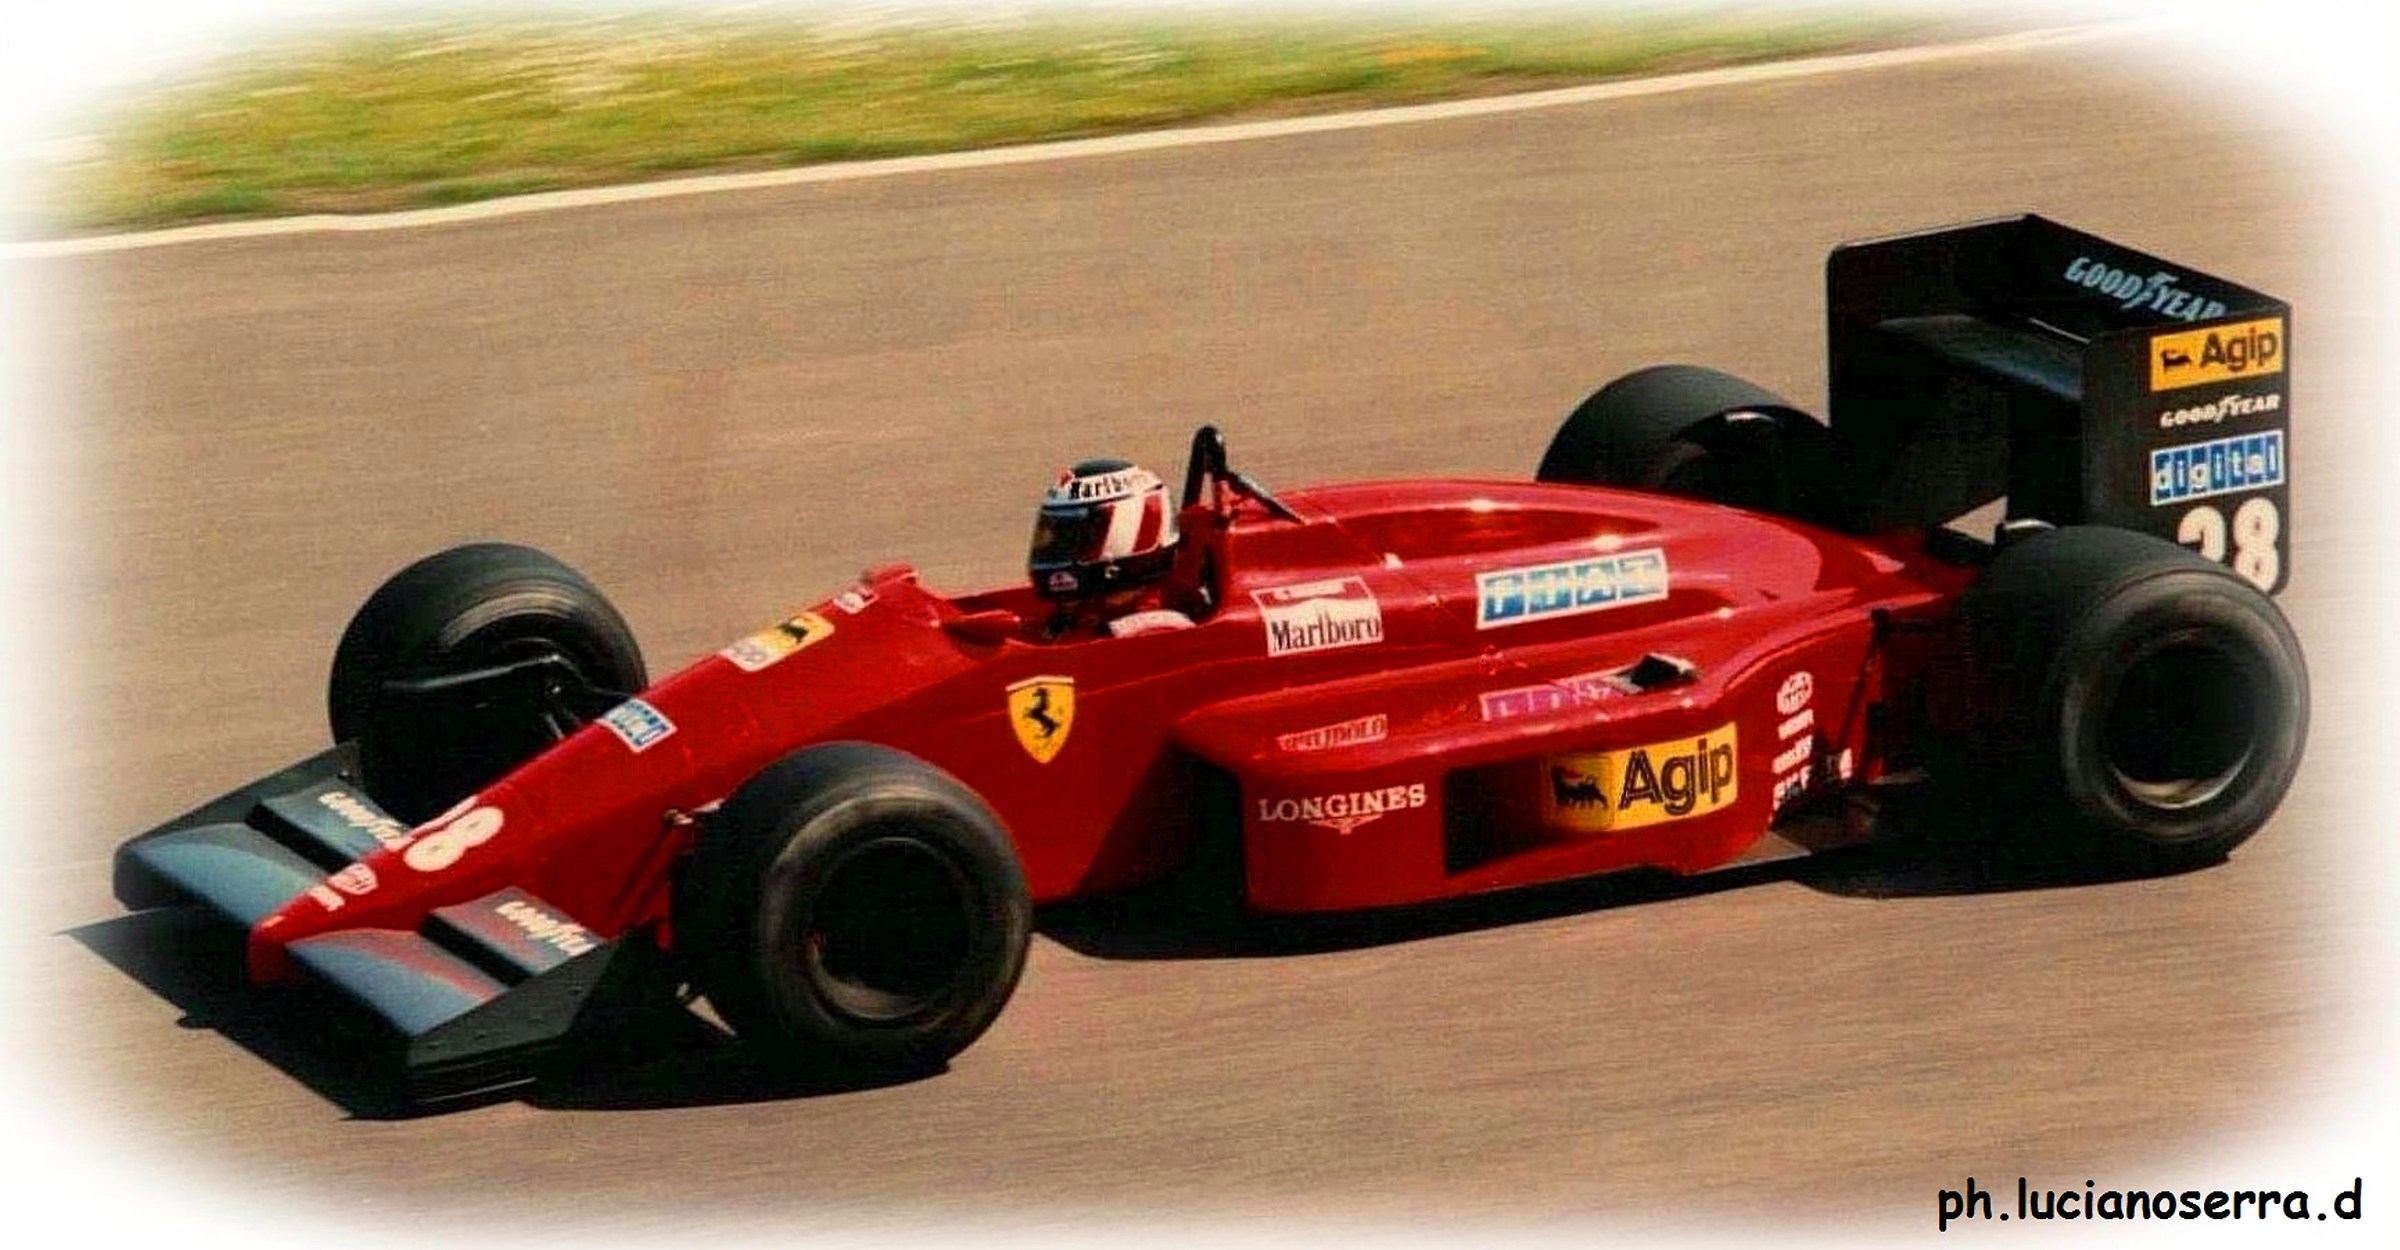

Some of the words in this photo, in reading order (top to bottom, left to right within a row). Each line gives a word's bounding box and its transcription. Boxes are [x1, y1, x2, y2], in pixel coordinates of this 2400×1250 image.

[2200, 327, 2278, 373] Agip
[2160, 393, 2281, 428] GOODYEAR
[2156, 444, 2278, 492] digital
[1271, 611, 1381, 653] Marlboro
[1617, 738, 1736, 813] Agip
[1258, 783, 1426, 822] LONGINES
